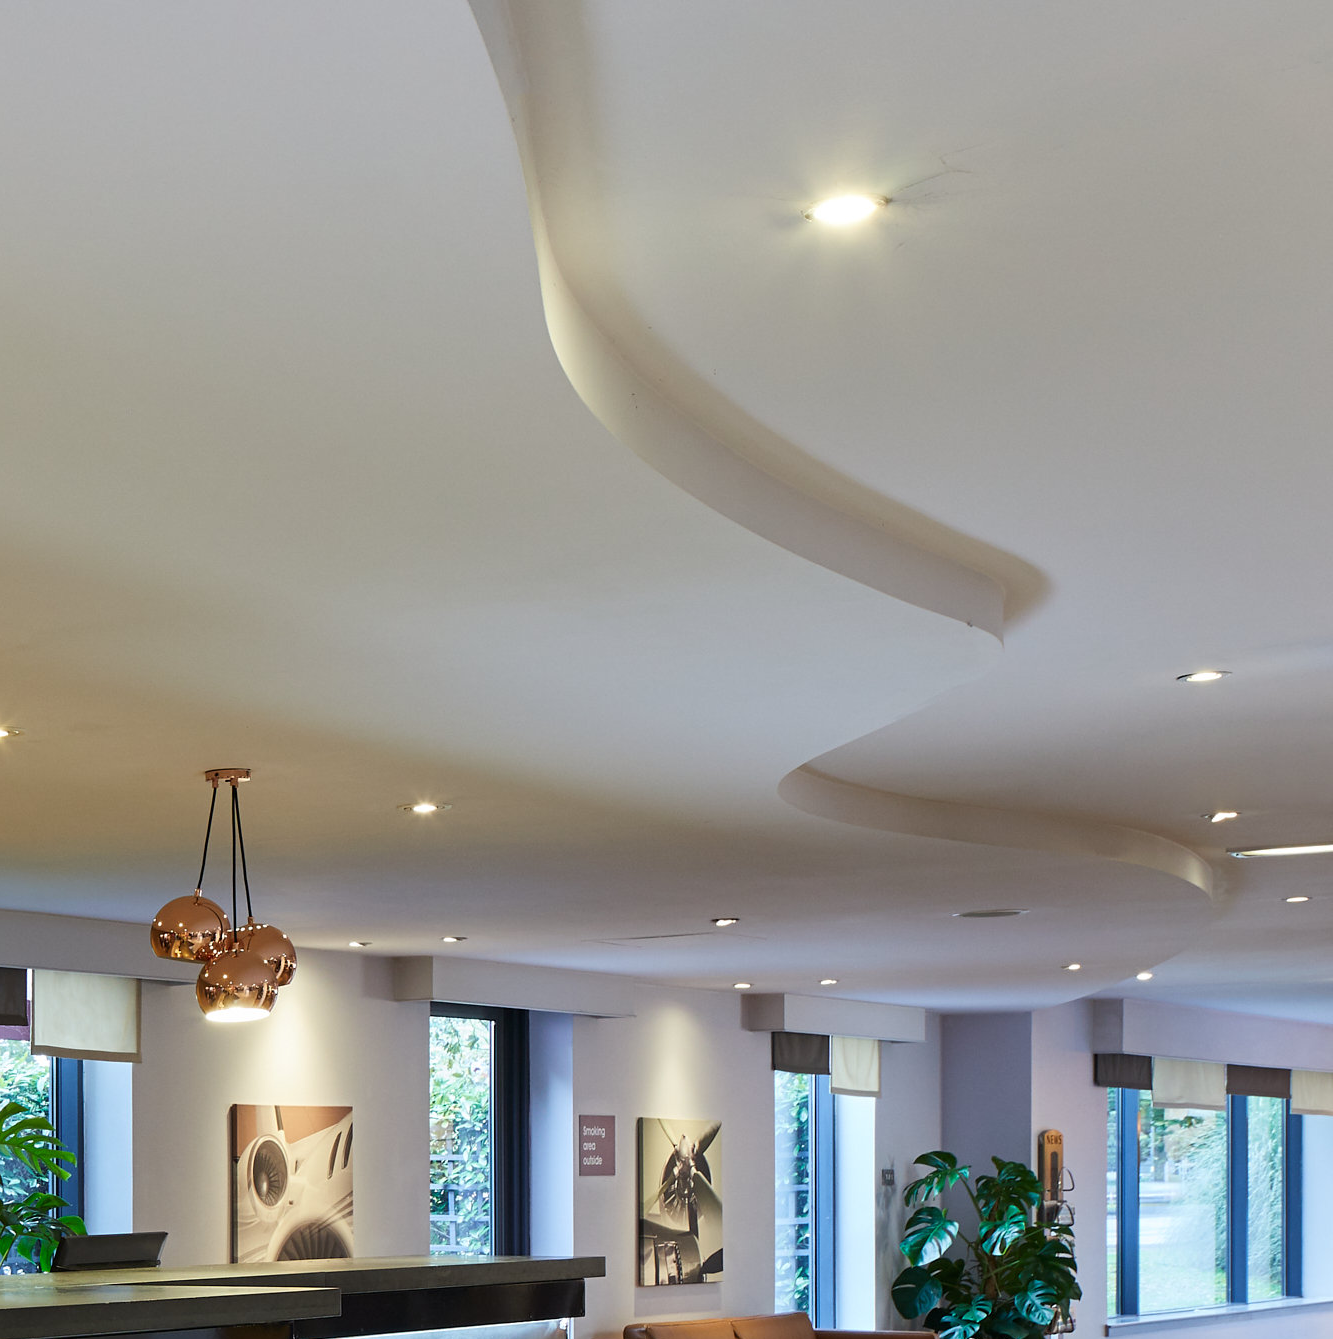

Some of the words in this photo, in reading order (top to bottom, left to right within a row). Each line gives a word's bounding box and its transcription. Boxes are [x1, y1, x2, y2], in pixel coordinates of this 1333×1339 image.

[583, 1125, 605, 1138] Smoking
[583, 1142, 596, 1150] area
[583, 1155, 602, 1165] outside
